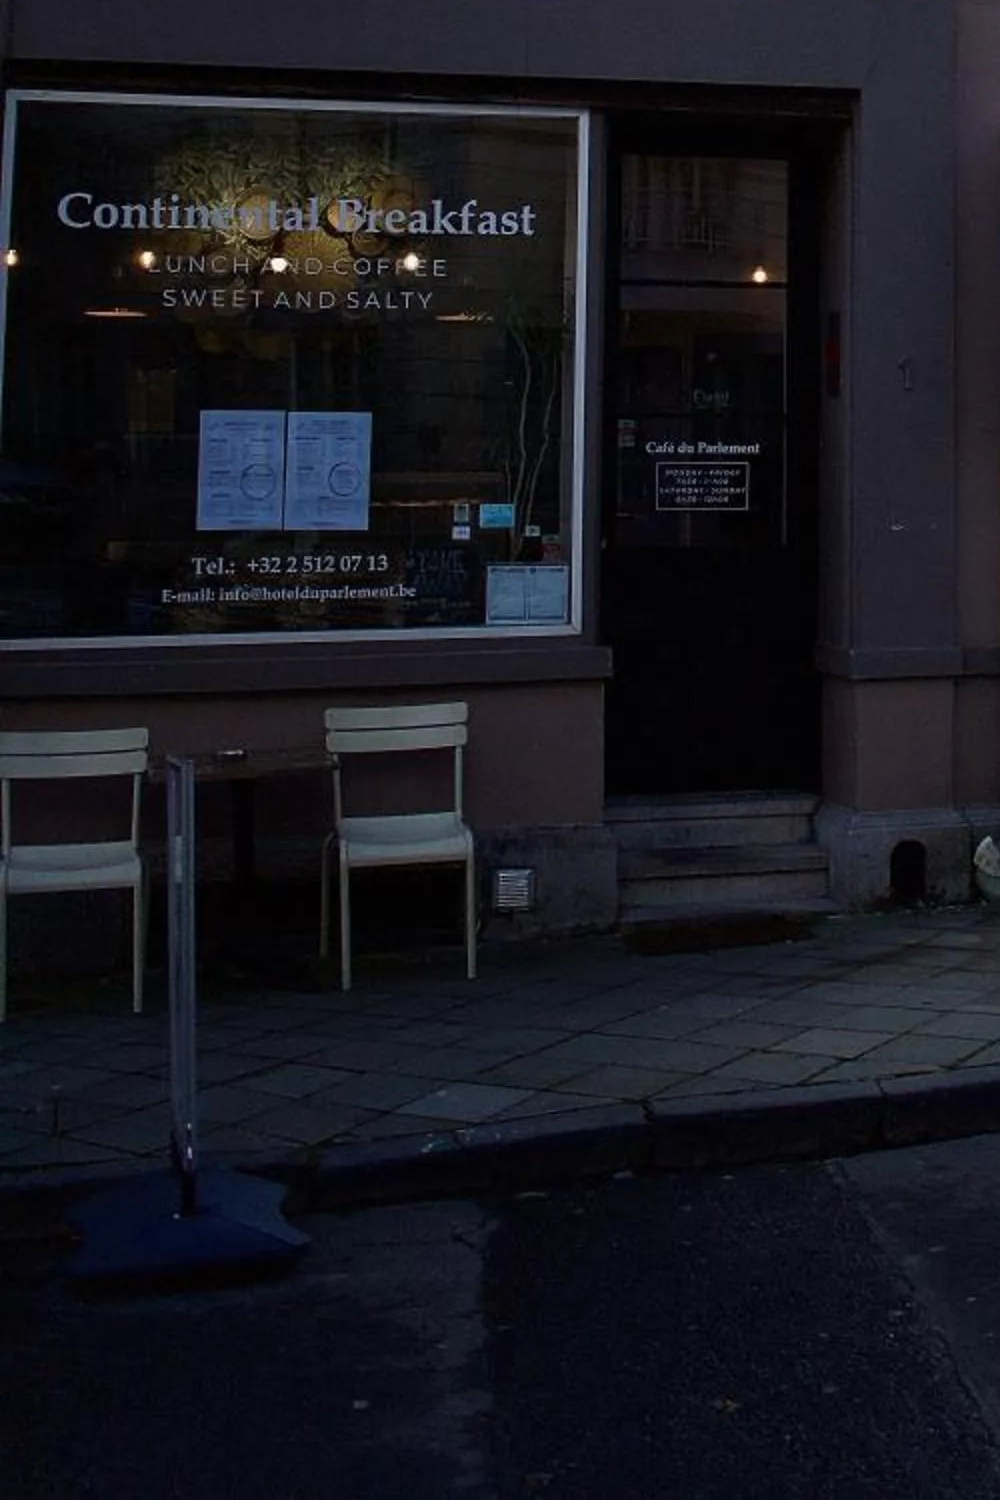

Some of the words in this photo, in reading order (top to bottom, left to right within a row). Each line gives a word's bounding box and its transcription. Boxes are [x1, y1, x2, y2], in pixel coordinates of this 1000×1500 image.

[57, 192, 319, 231] Continental
[337, 197, 536, 237] Breakfast
[261, 257, 323, 276] AND
[332, 258, 448, 278] COFFEE
[163, 288, 262, 308] SWEET
[272, 290, 336, 309] AND
[346, 290, 433, 310] SALTY
[645, 441, 675, 453] Café
[677, 441, 695, 453] du
[697, 440, 760, 453] Parlement
[247, 555, 281, 574] +32
[284, 556, 297, 573] 2
[301, 555, 335, 573] 512
[339, 555, 362, 572] 07
[365, 553, 389, 572] 13
[161, 587, 215, 604] E-mail:
